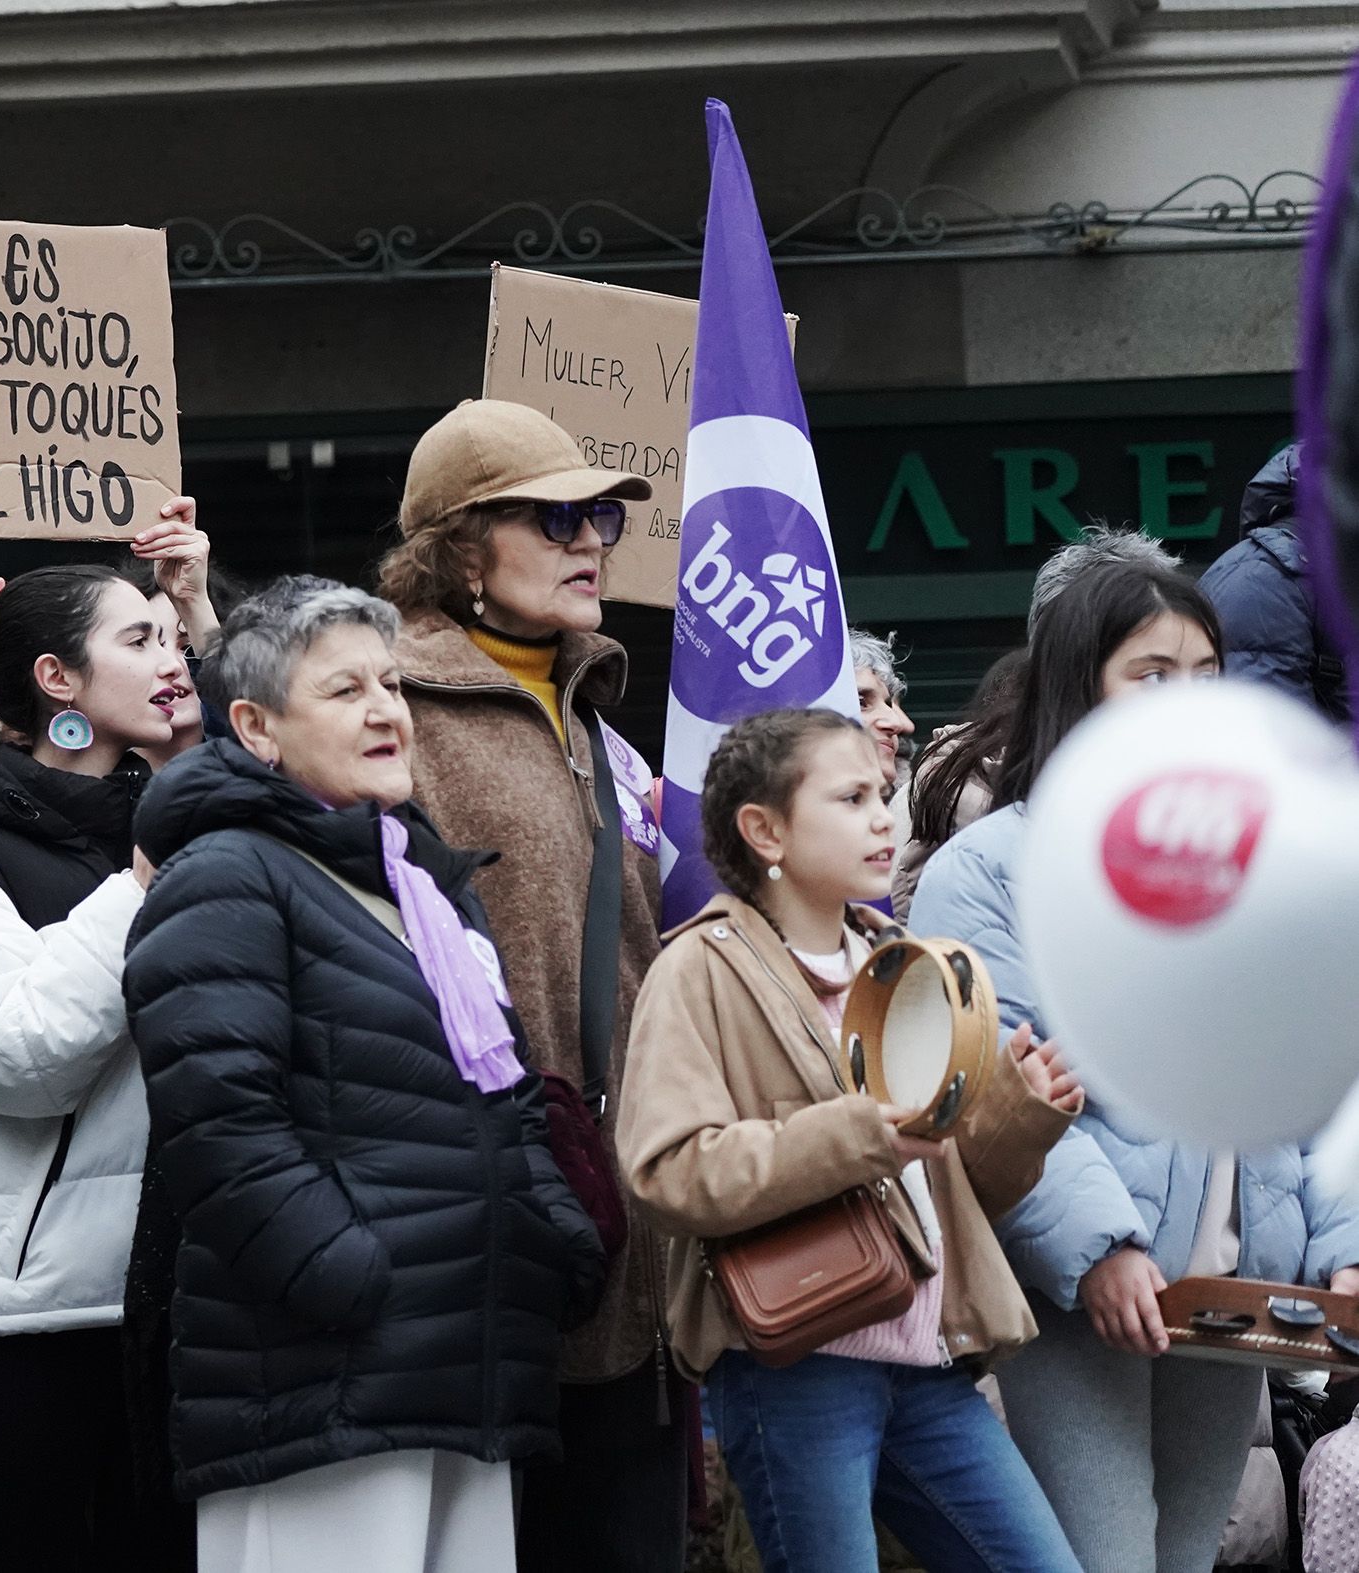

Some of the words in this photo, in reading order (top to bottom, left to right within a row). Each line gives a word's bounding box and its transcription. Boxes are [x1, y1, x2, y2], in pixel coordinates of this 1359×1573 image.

[2, 233, 60, 306] ES
[521, 316, 634, 409] MULLER,
[18, 443, 136, 529] HIGO
[572, 430, 688, 483] BERDA
[866, 438, 1292, 552] ARE
[681, 520, 814, 689] bng
